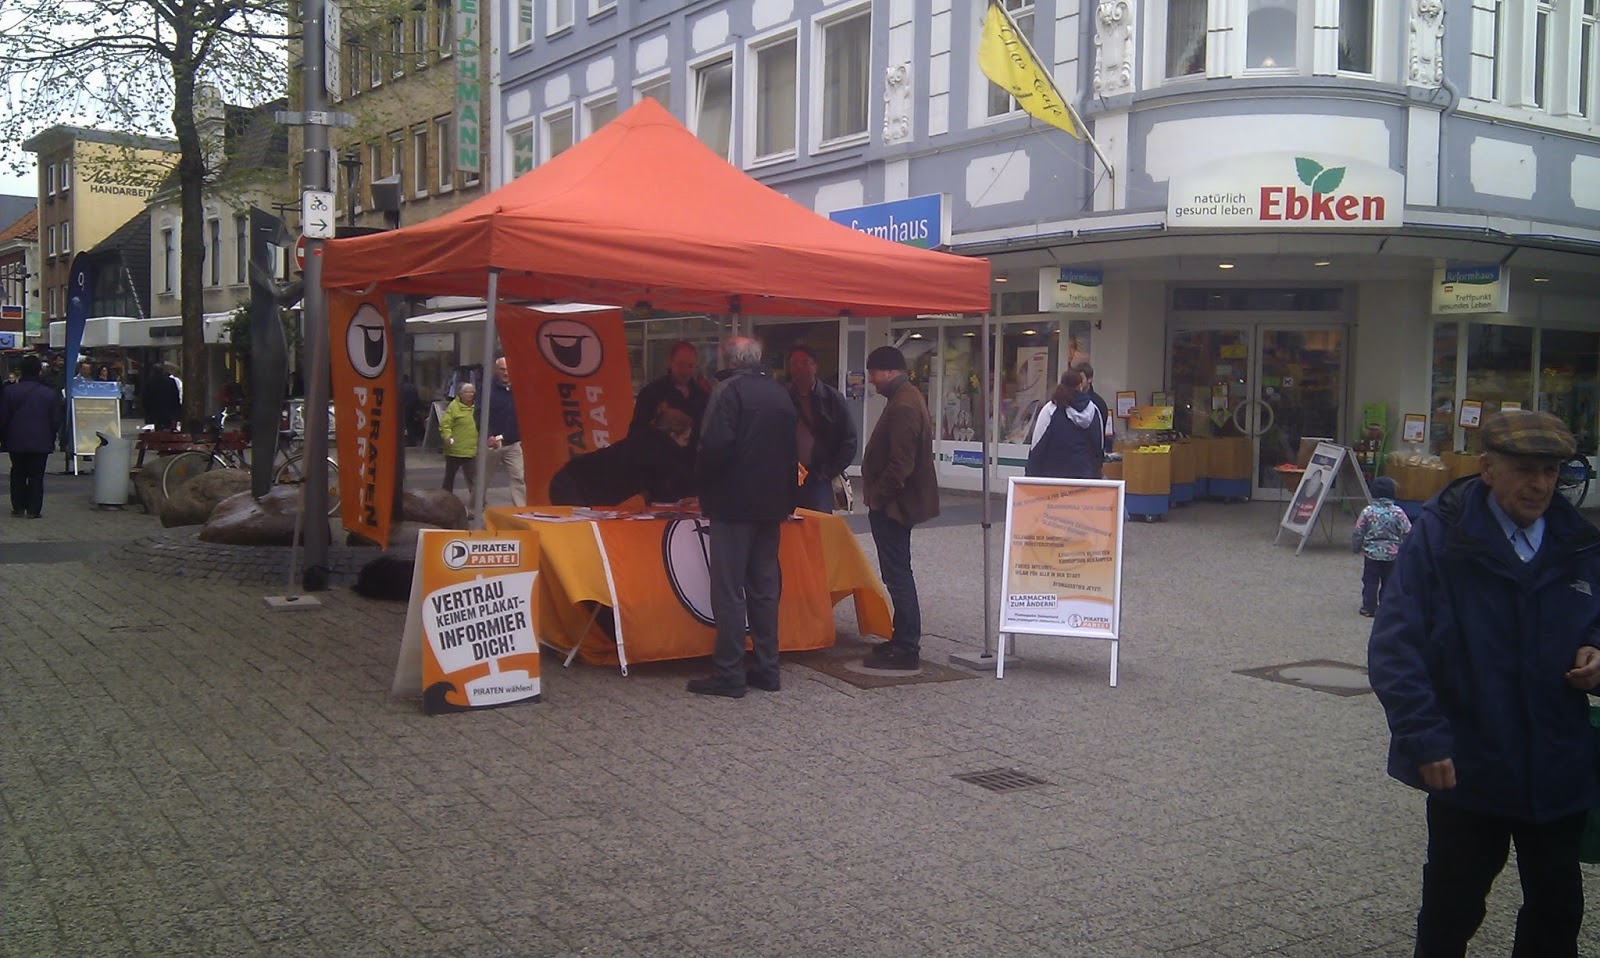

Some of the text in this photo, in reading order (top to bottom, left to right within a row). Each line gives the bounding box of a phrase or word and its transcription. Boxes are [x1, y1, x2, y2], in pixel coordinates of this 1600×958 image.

[1194, 192, 1246, 204] natürlich
[1259, 186, 1385, 221] Ebken
[1175, 203, 1254, 218] gesund leben
[1446, 270, 1495, 283] Reformhaus
[1455, 293, 1492, 303] Treffpunkt
[1438, 301, 1492, 312] gesundes Leben
[364, 387, 384, 527] PIRATEN
[471, 543, 516, 553] PIRATEN
[471, 554, 516, 564] PARTEI
[431, 580, 505, 614] VERTRAU
[435, 609, 476, 628] KEINEM
[438, 611, 527, 650] INFORMIER
[472, 635, 515, 661] DICH!
[472, 684, 534, 696] PIRATEN wählen!
